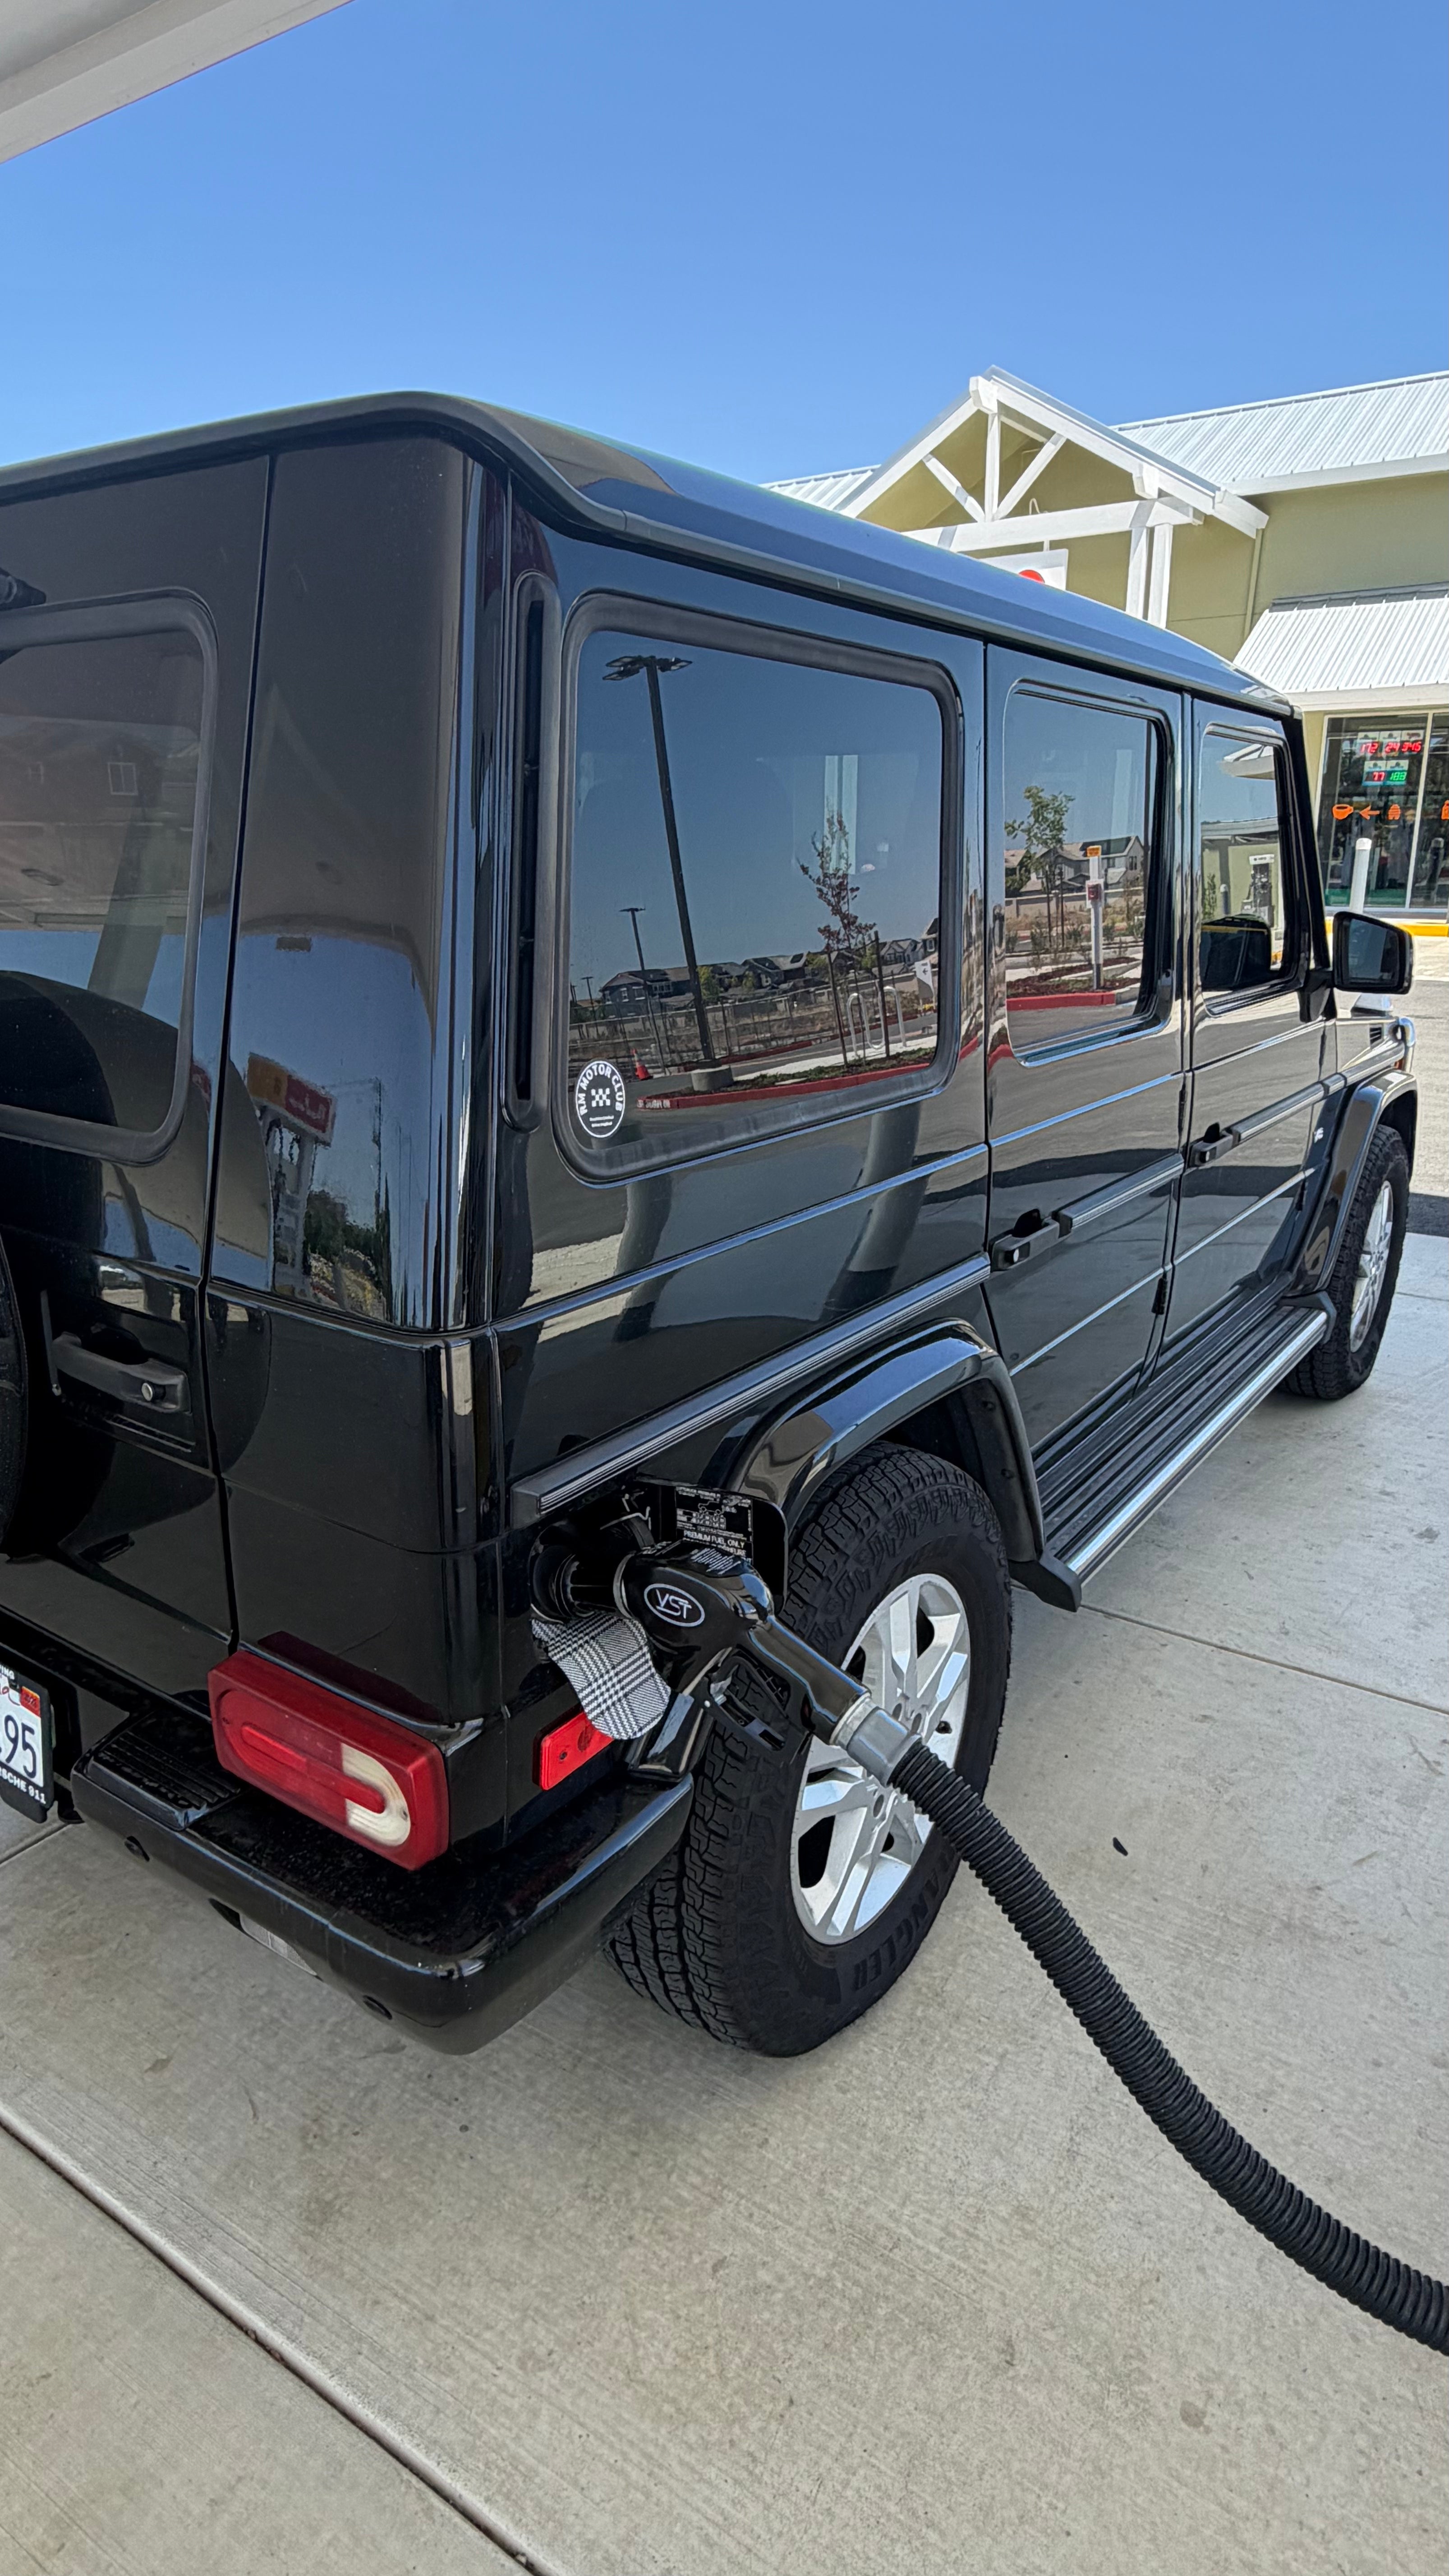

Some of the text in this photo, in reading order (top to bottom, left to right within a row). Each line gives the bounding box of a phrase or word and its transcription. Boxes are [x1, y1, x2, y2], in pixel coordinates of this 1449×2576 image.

[580, 1064, 612, 1090] MOTOR
[727, 1539, 745, 1548] ONLY
[655, 1588, 692, 1619] VST
[0, 1714, 37, 1779] 95
